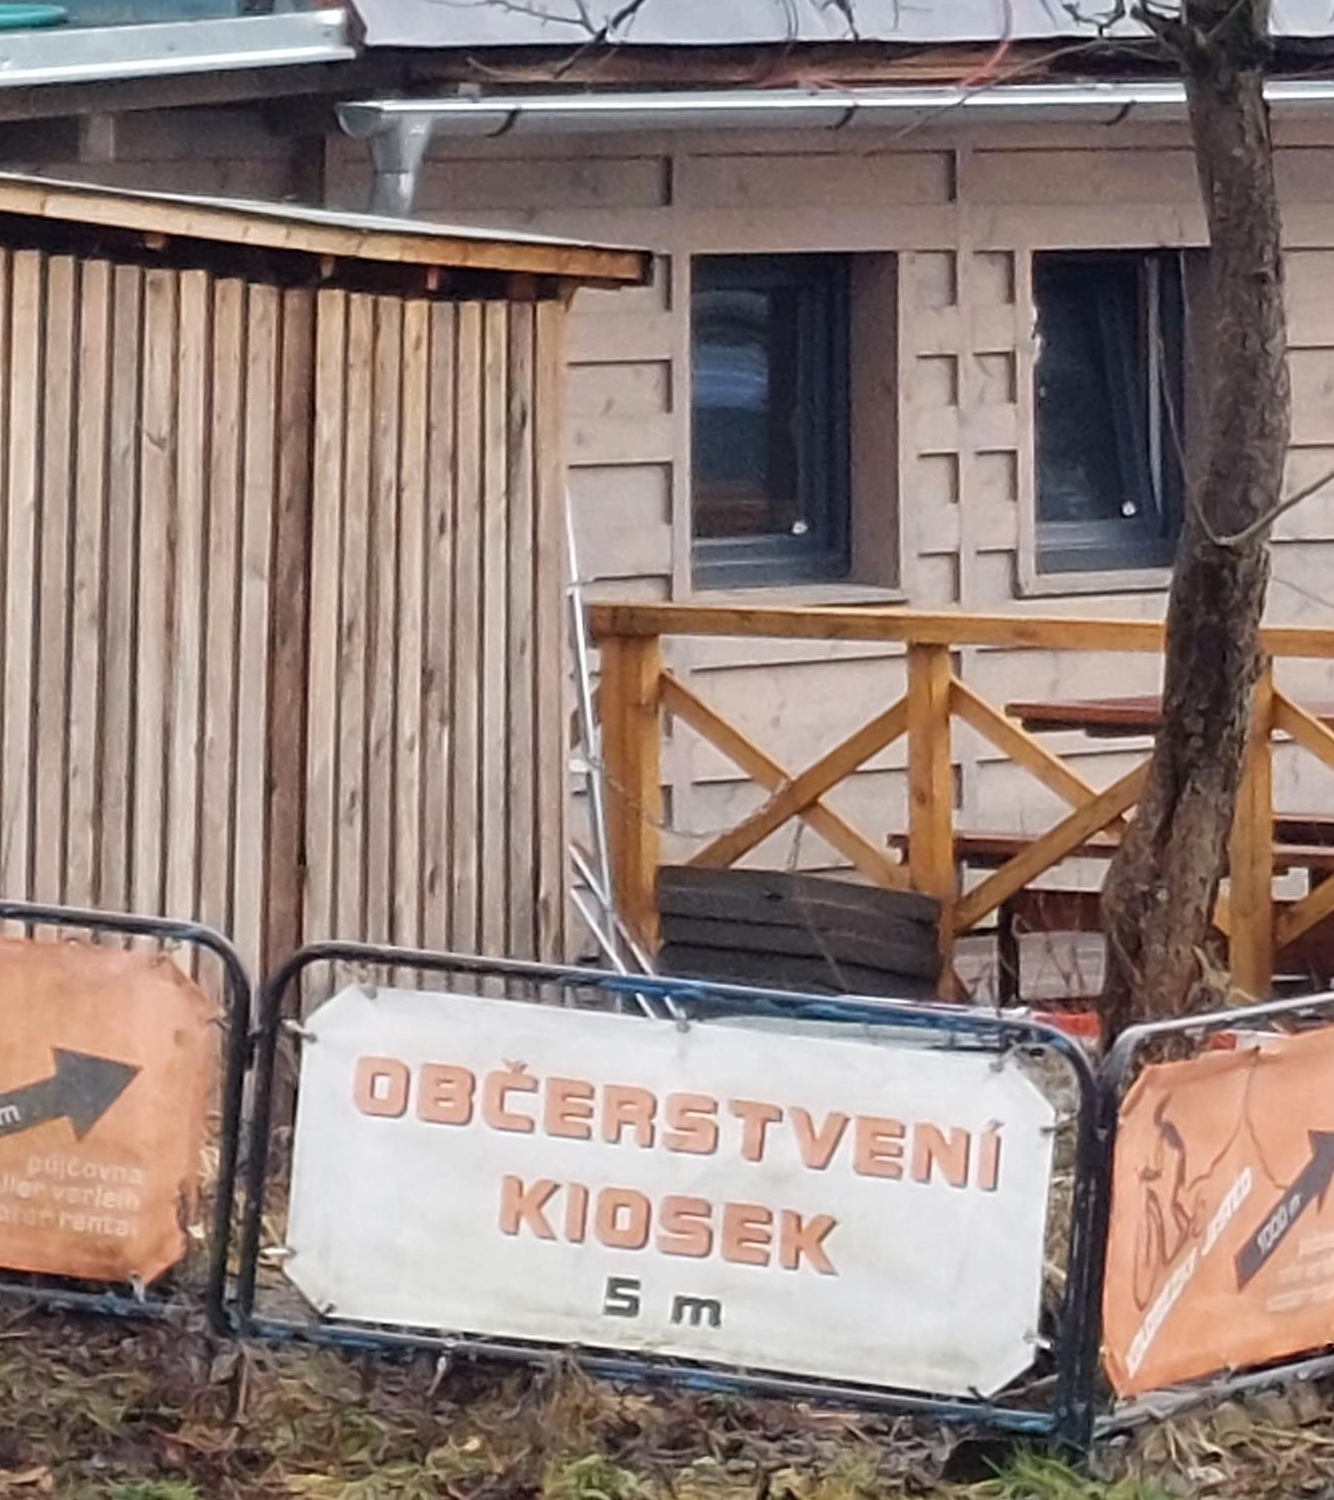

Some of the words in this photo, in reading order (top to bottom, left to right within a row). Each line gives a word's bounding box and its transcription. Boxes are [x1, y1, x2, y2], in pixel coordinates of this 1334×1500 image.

[352, 1056, 1003, 1192] OBČERSTVENÍ
[498, 1174, 840, 1276] KIOSEK
[603, 1276, 643, 1319] 5
[669, 1293, 723, 1329] m
